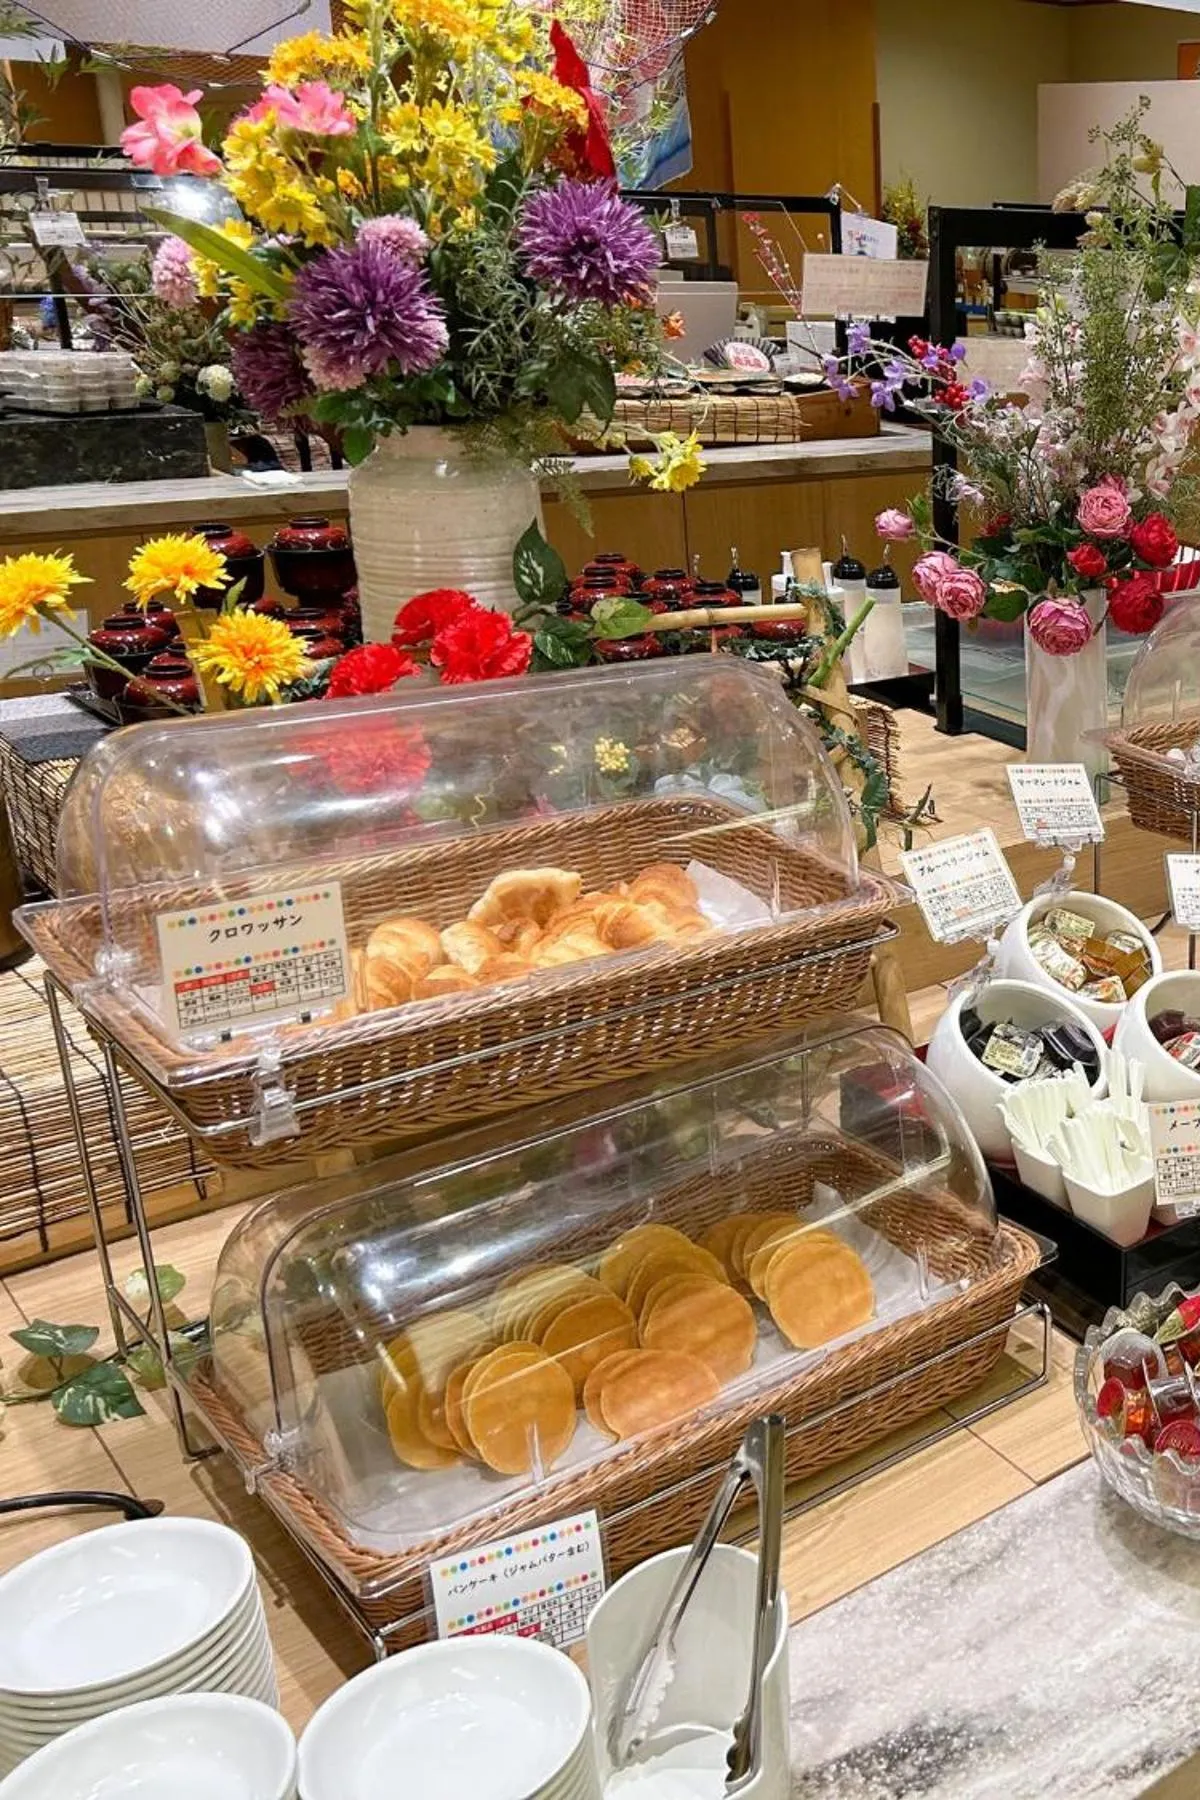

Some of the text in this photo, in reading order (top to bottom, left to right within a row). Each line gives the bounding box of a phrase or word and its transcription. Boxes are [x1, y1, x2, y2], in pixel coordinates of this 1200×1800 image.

[208, 914, 302, 943] クロワッサン
